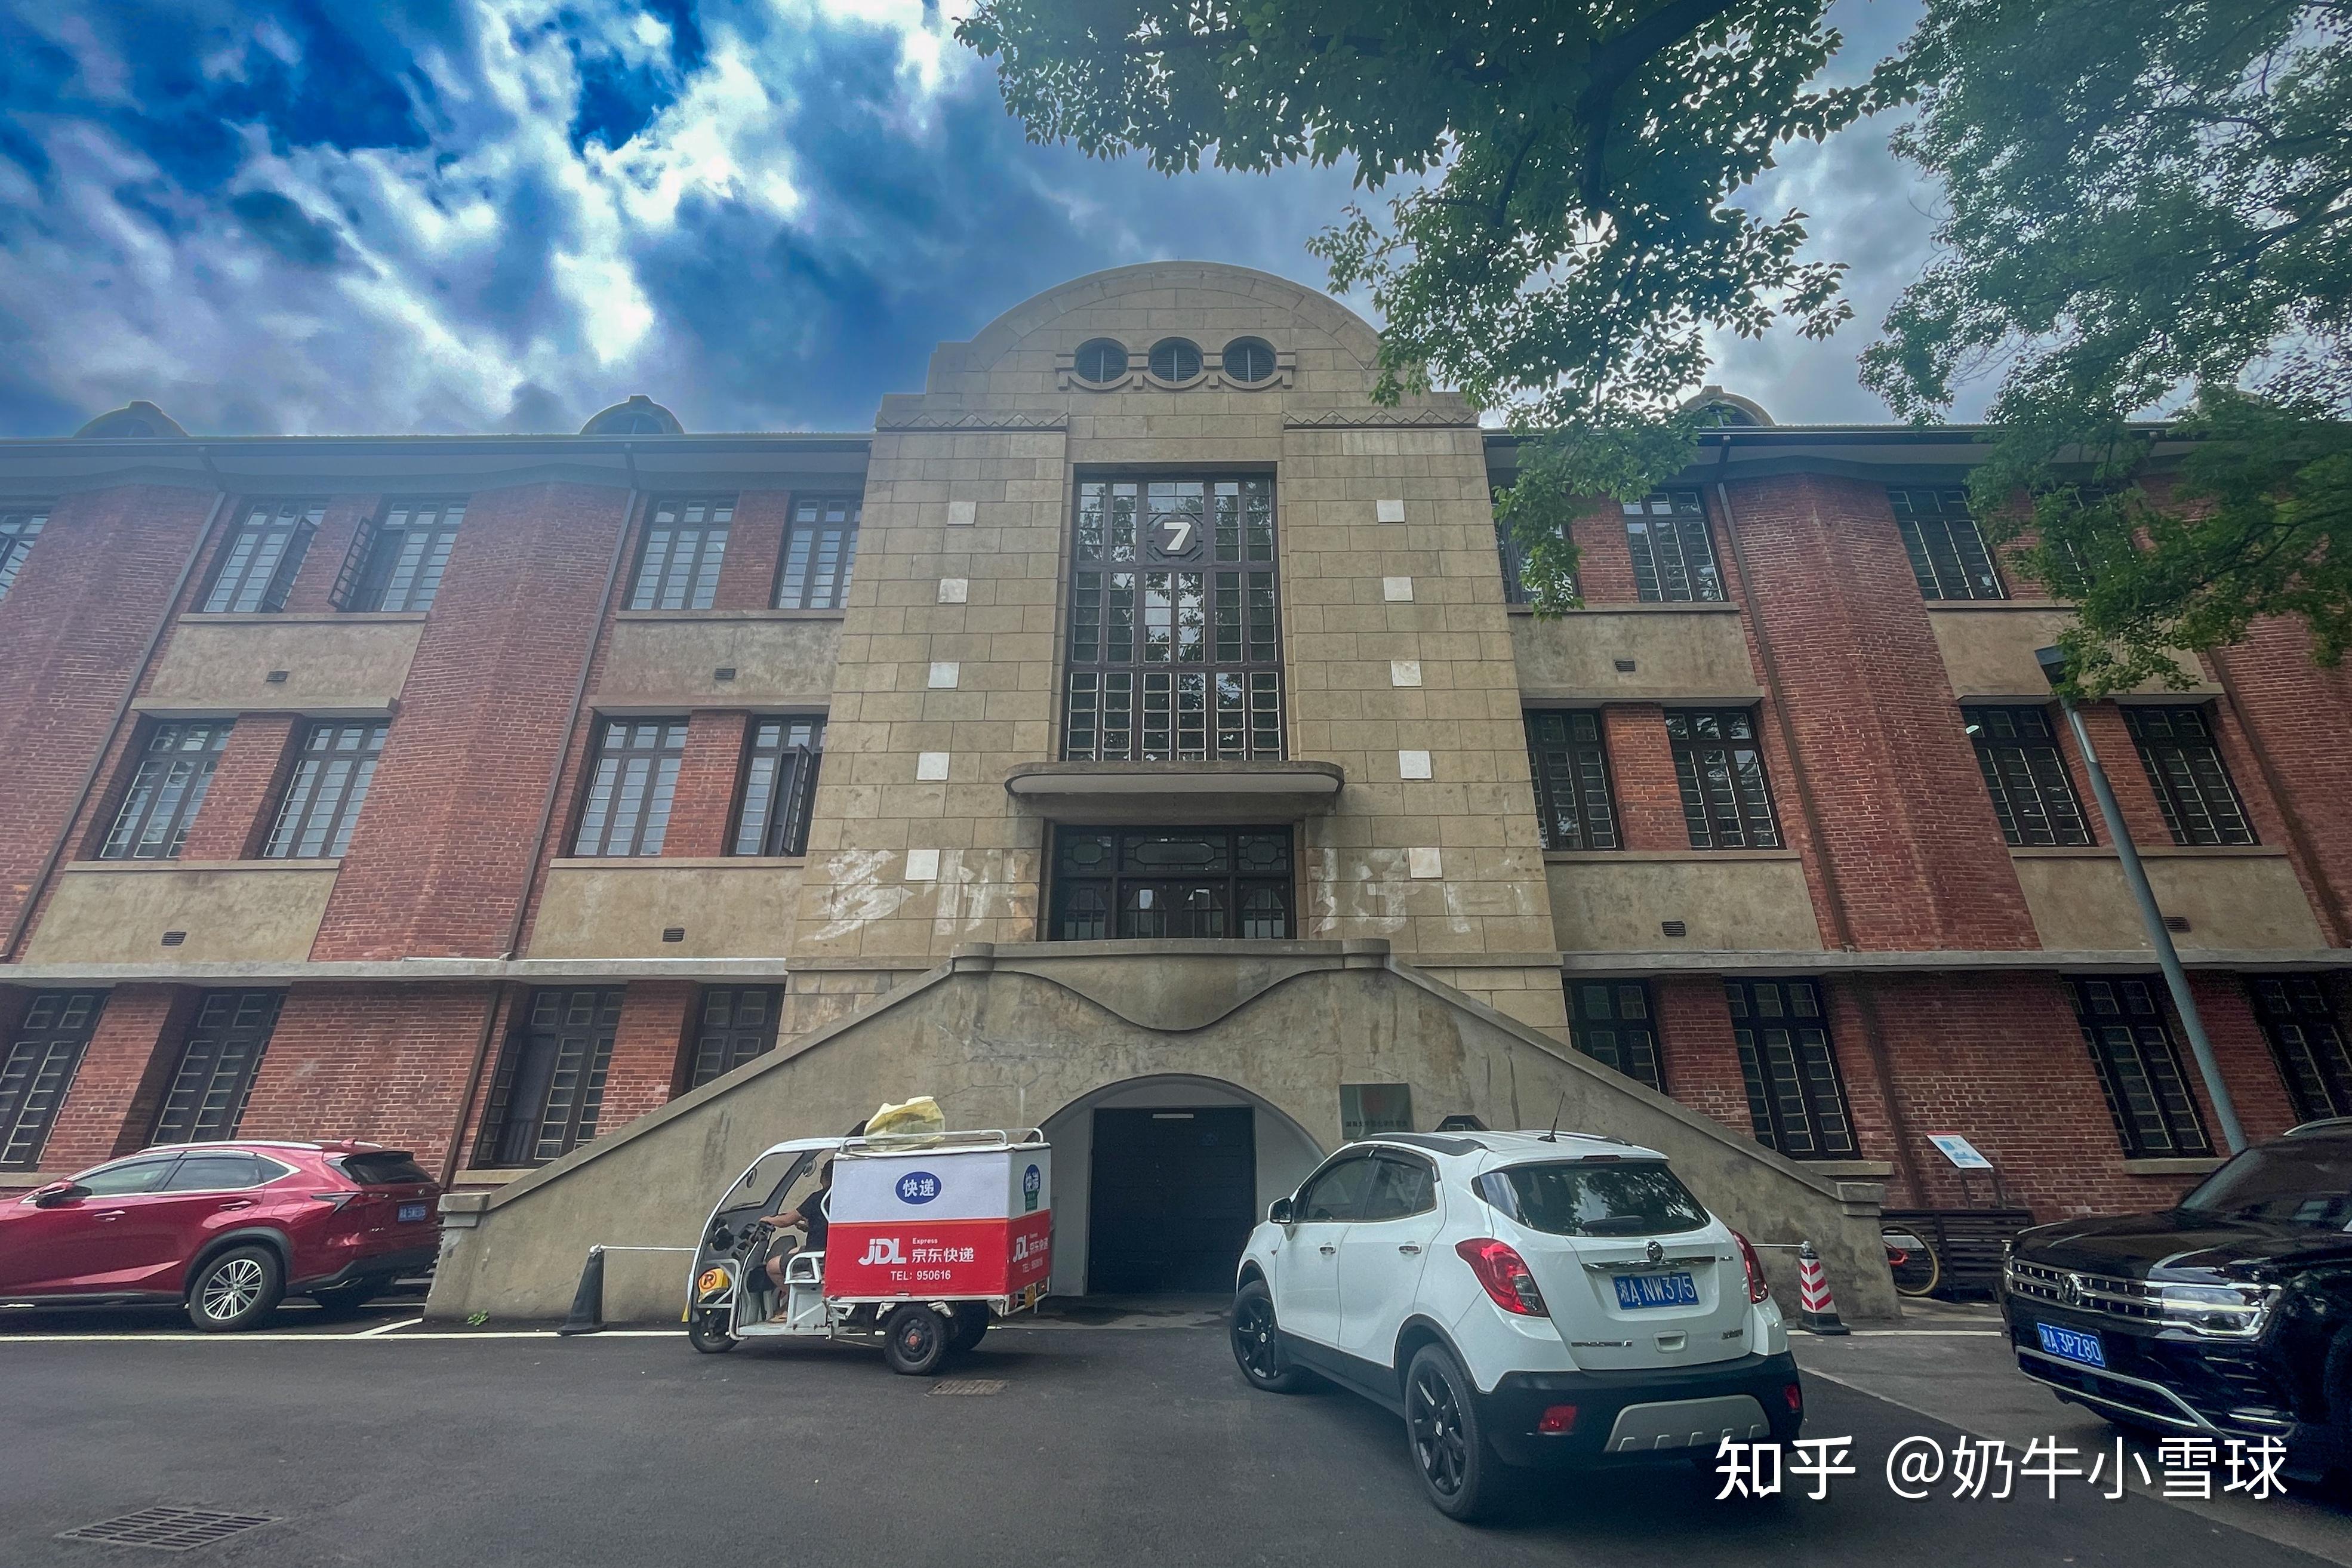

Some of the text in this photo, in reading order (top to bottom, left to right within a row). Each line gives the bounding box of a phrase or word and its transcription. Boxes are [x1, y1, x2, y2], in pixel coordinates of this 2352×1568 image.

[1164, 522, 1192, 551] 7
[903, 1178, 935, 1197] 快递
[858, 1237, 907, 1266] JDL
[912, 1247, 974, 1264] 京东快递
[916, 1270, 951, 1280] 950616
